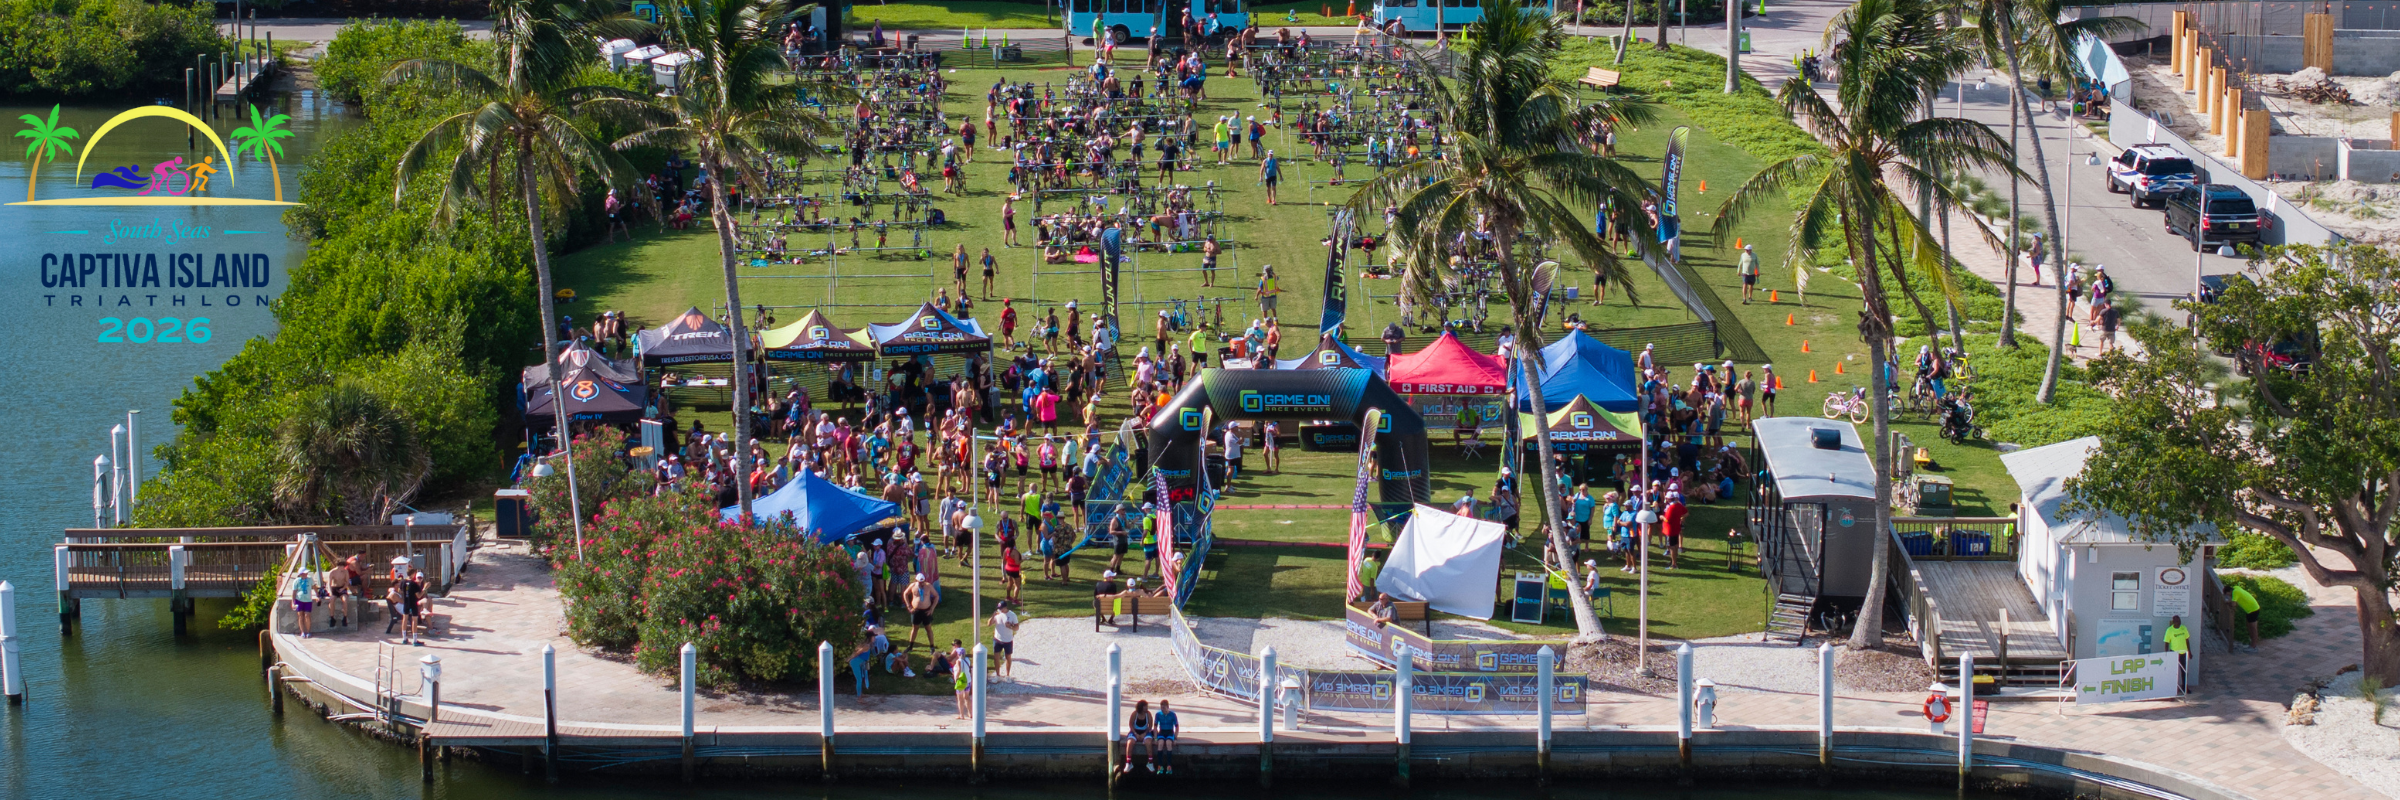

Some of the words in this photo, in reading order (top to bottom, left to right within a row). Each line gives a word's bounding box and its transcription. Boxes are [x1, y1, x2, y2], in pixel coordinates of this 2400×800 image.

[1103, 249, 1113, 282] OUT
[1331, 259, 1345, 301] RUN
[1106, 284, 1115, 316] RUN
[670, 331, 722, 341] TREK
[892, 345, 920, 354] GAME
[922, 344, 939, 352] ON!
[661, 354, 733, 364] TREKBIKESTOREUSA.CO
[775, 351, 805, 359] GAME
[1419, 384, 1454, 393] FIRST
[1456, 384, 1477, 393] AID
[1264, 394, 1304, 405] GAME
[1307, 394, 1330, 405] ON!
[575, 413, 593, 421] Flow
[594, 413, 603, 421] IV
[1549, 431, 1589, 439] GAME
[1592, 430, 1617, 438] ON!
[1569, 443, 1587, 451] ON!
[1346, 619, 1367, 638] GAME
[1367, 629, 1383, 644] ON!
[1438, 654, 1460, 662] ON!
[1500, 653, 1538, 664] GAME
[2110, 658, 2146, 675] LAP
[2100, 676, 2154, 695] FINISH
